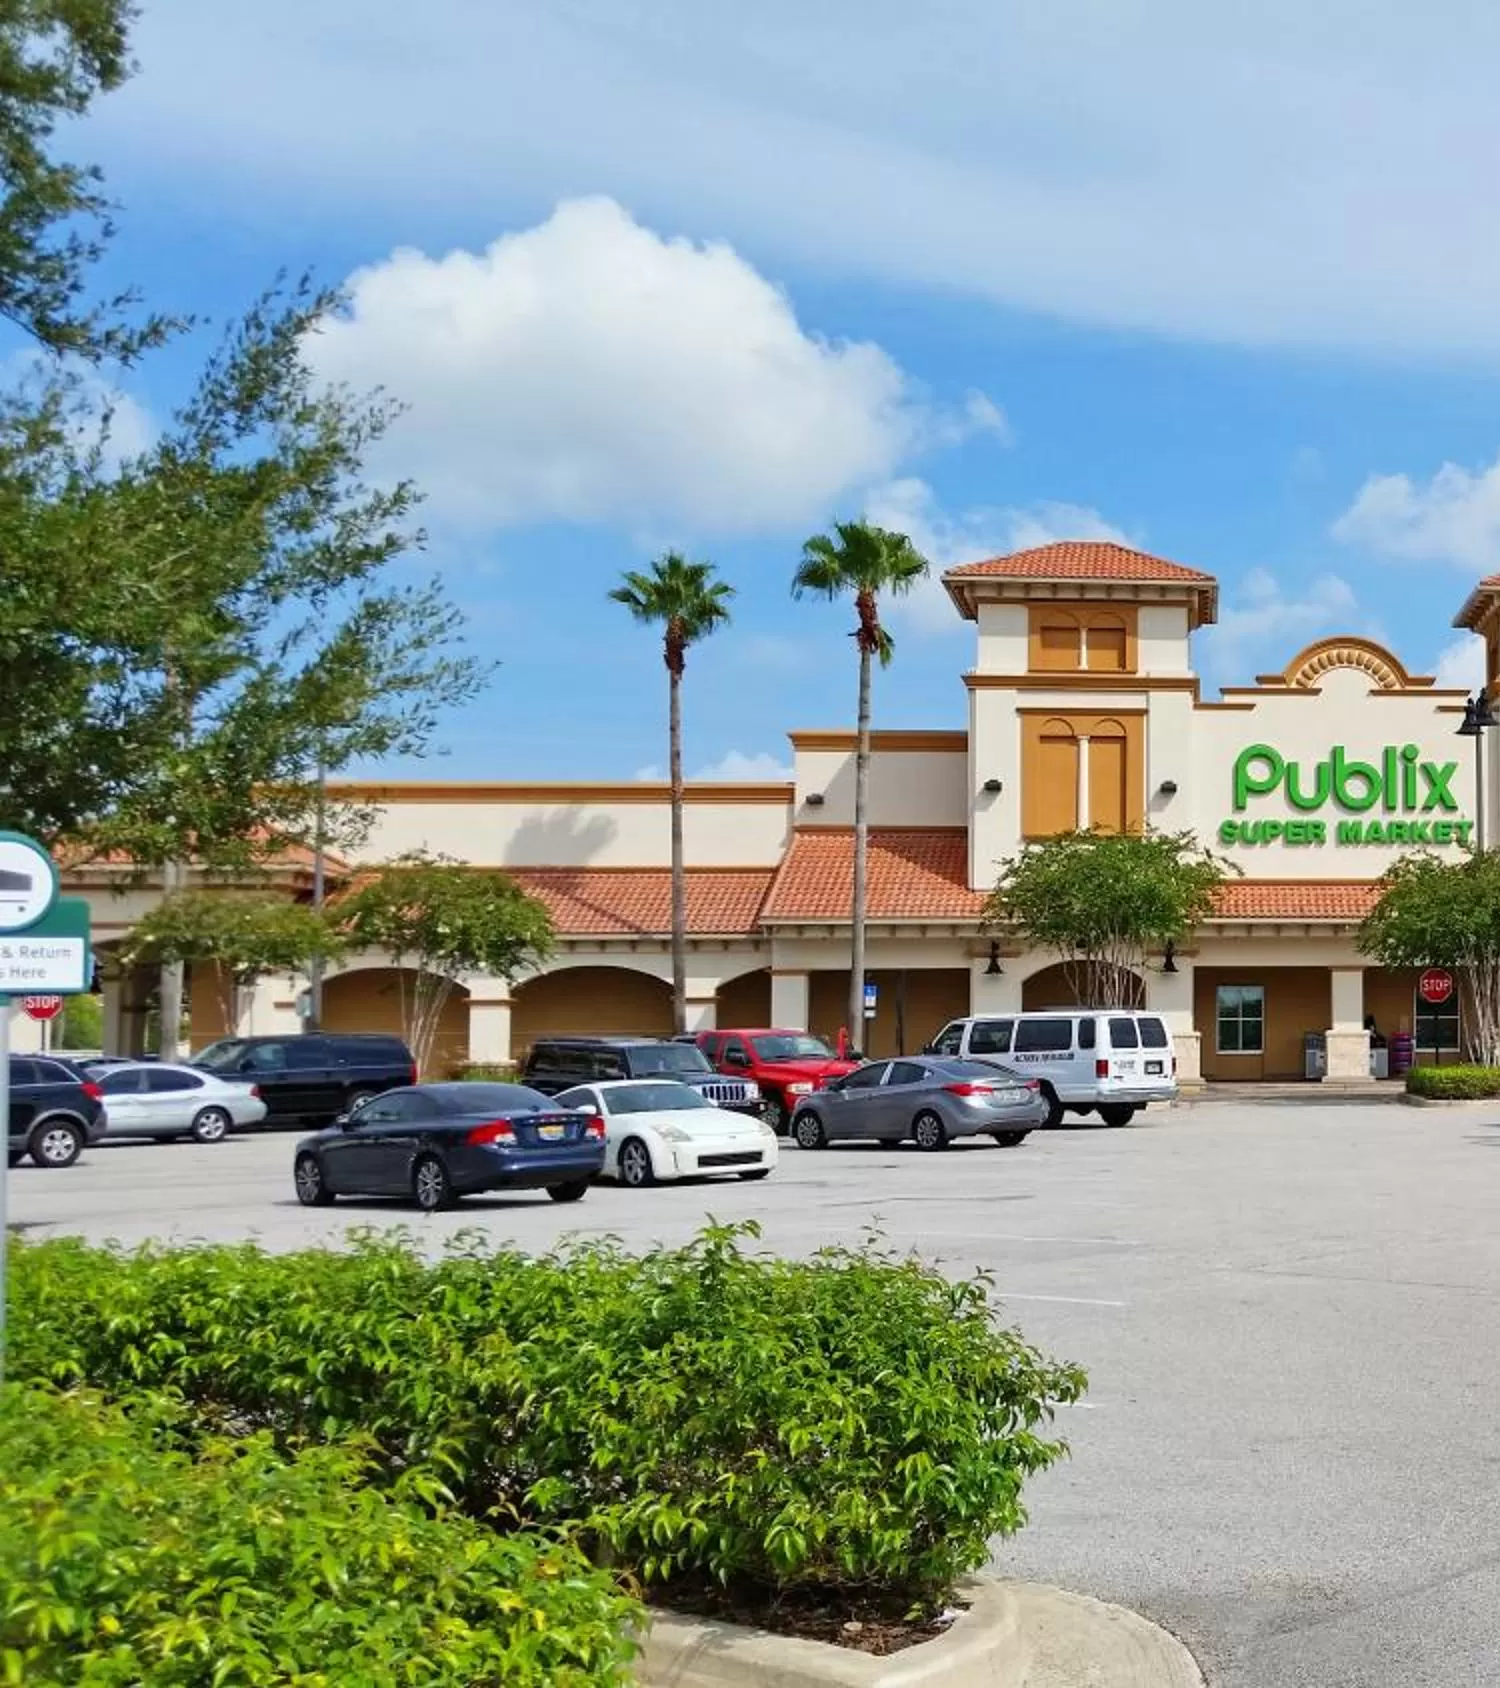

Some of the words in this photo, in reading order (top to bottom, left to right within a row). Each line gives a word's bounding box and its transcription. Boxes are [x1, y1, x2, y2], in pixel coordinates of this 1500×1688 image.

[1232, 743, 1458, 811] Publix
[1218, 819, 1327, 845] SUPER
[1337, 819, 1474, 845] MARKET
[19, 946, 73, 958] Return
[9, 967, 47, 978] Here
[1423, 979, 1449, 991] STOP
[27, 995, 60, 1008] STOP
